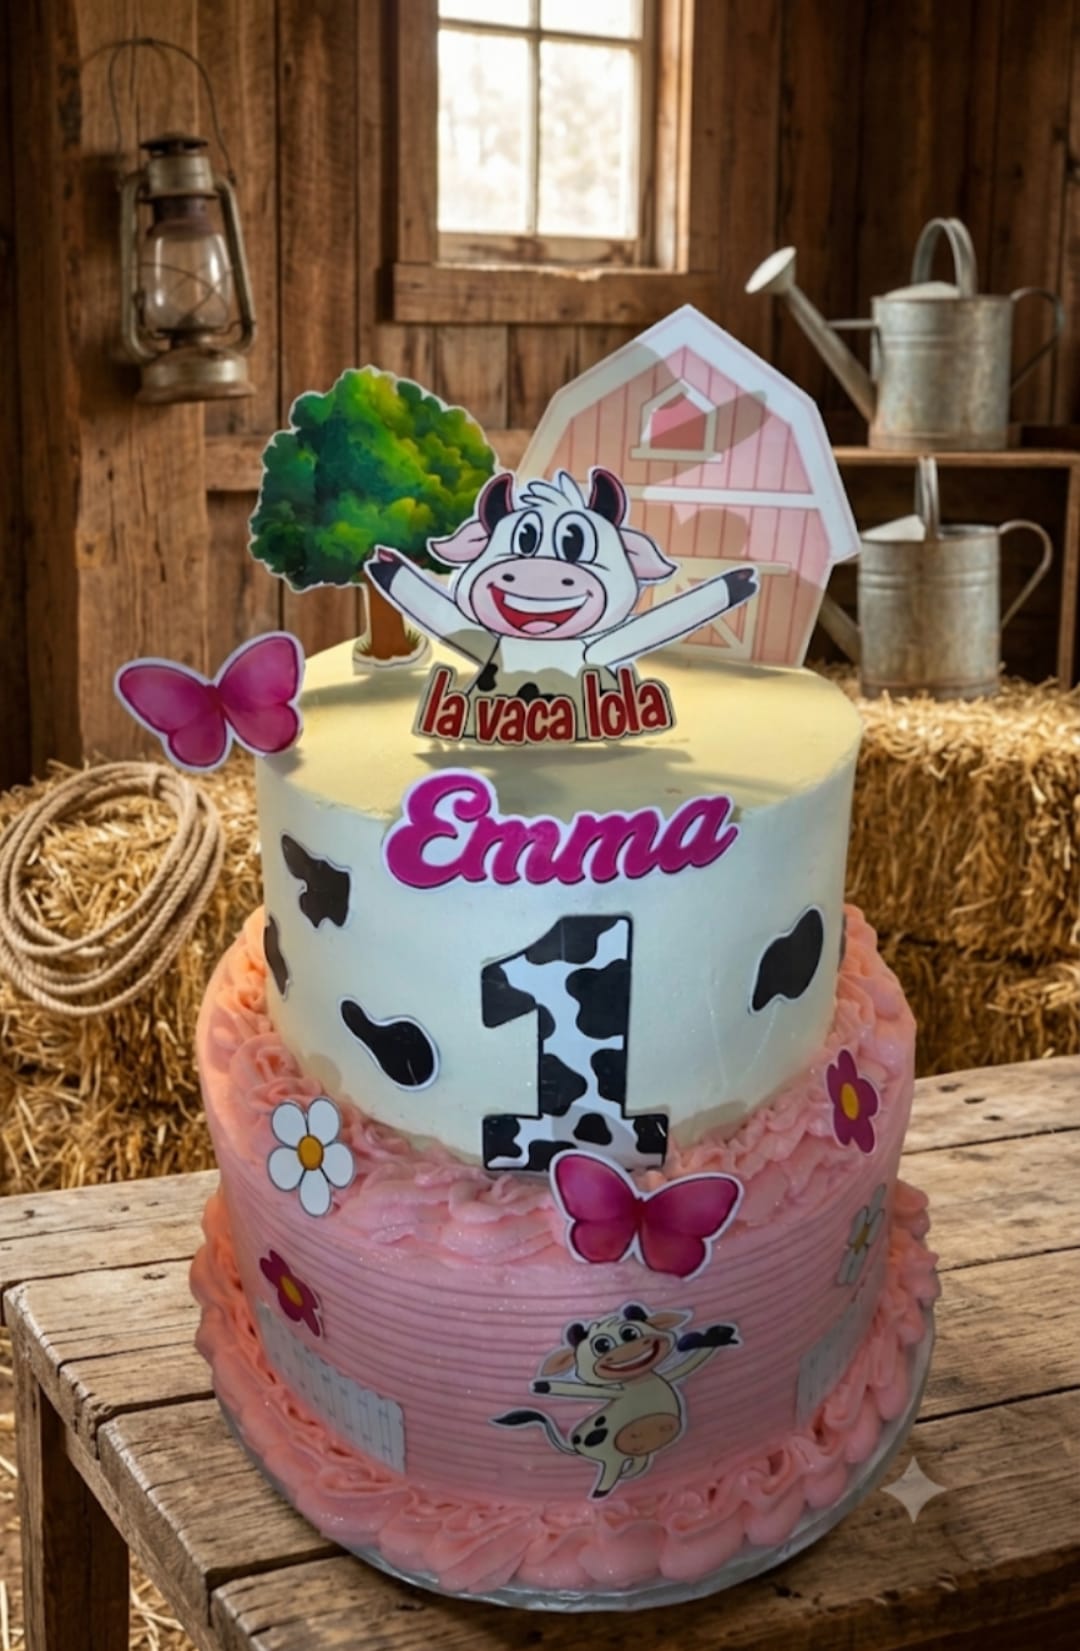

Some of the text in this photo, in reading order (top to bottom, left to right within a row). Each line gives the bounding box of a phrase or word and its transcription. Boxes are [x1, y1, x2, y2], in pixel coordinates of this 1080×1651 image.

[421, 666, 670, 743] la vaca lola
[386, 773, 737, 889] Emma
[481, 914, 669, 1171] 1
